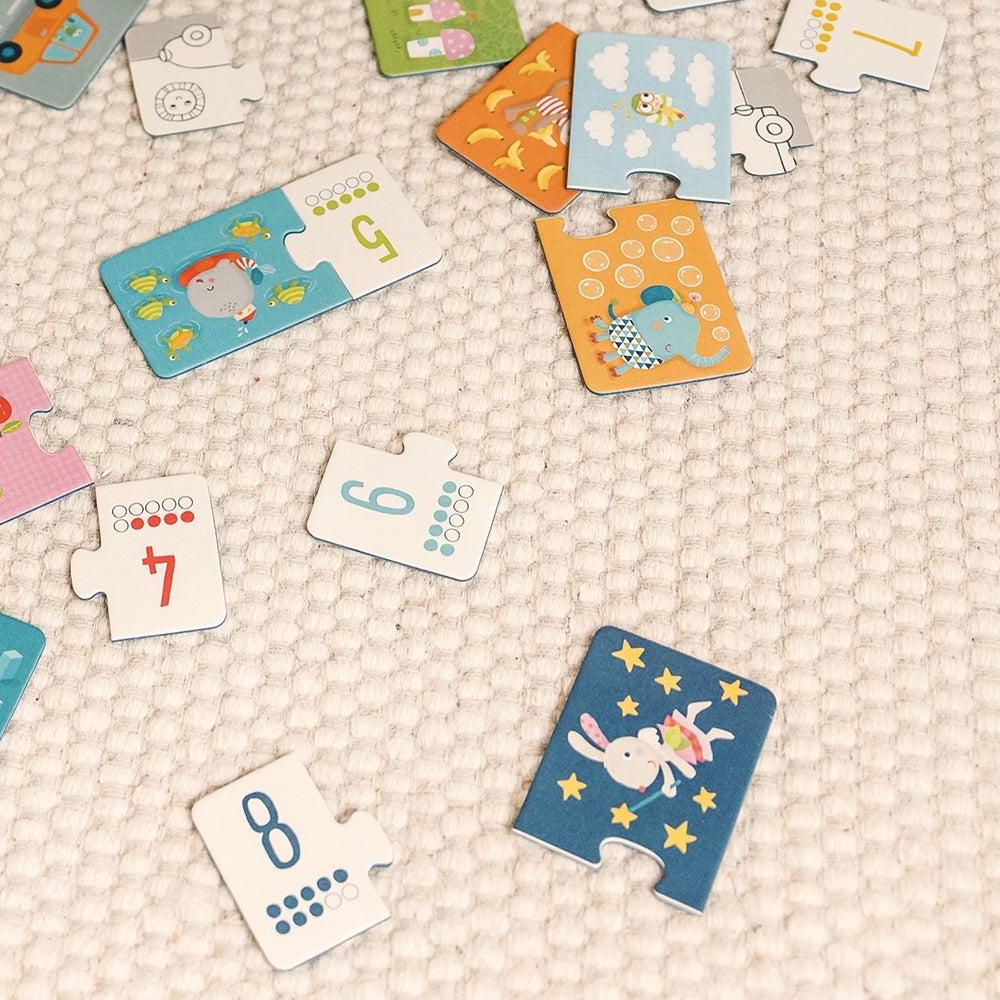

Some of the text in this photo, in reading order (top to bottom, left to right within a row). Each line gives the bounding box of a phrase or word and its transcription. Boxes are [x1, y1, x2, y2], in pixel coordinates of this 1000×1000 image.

[852, 29, 923, 57] 7
[350, 214, 399, 264] 5
[340, 479, 417, 517] 6
[141, 545, 176, 608] 4
[241, 790, 301, 871] 8
